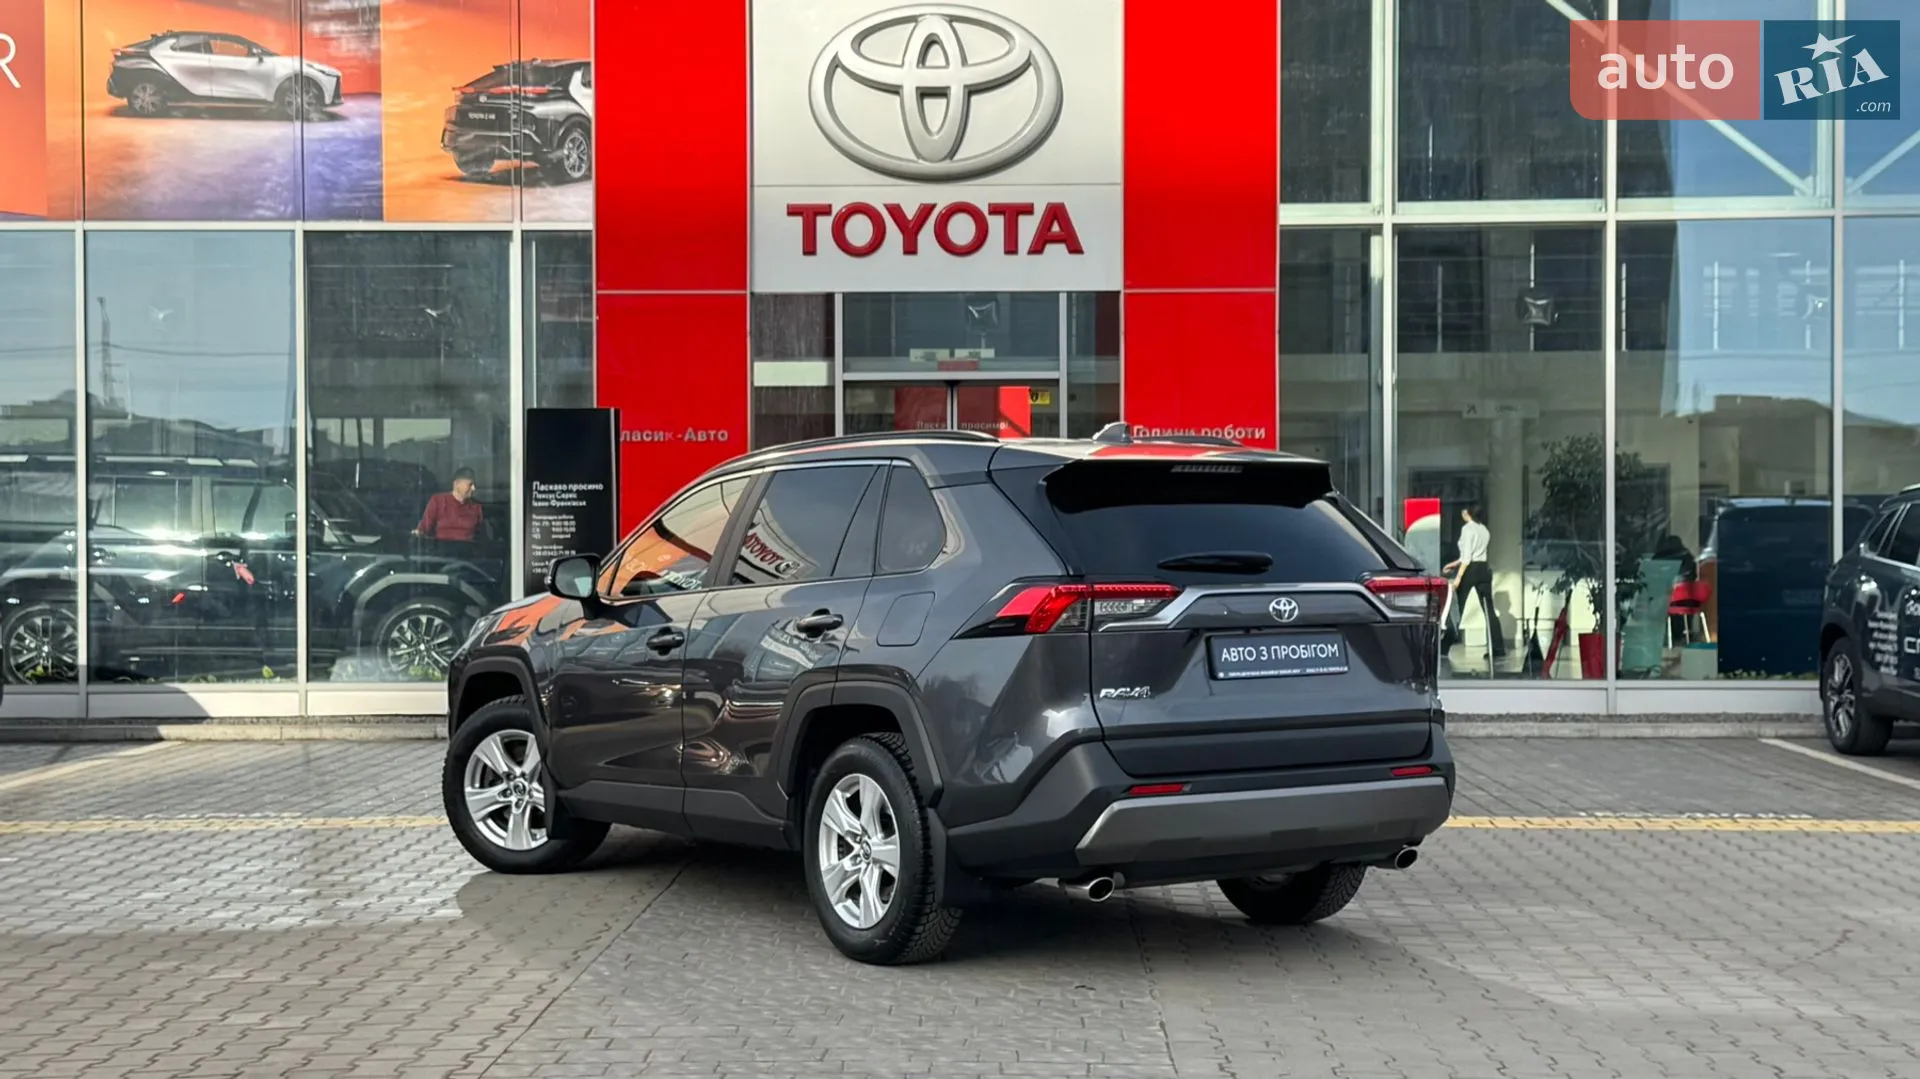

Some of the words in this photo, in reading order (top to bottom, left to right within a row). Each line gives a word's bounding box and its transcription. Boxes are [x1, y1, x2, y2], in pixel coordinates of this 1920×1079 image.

[786, 201, 1085, 258] TOYOTA
[619, 427, 729, 442] ласик-Авто
[1221, 647, 1257, 662] АВТО
[1271, 643, 1340, 660] ПРОБІГОМ
